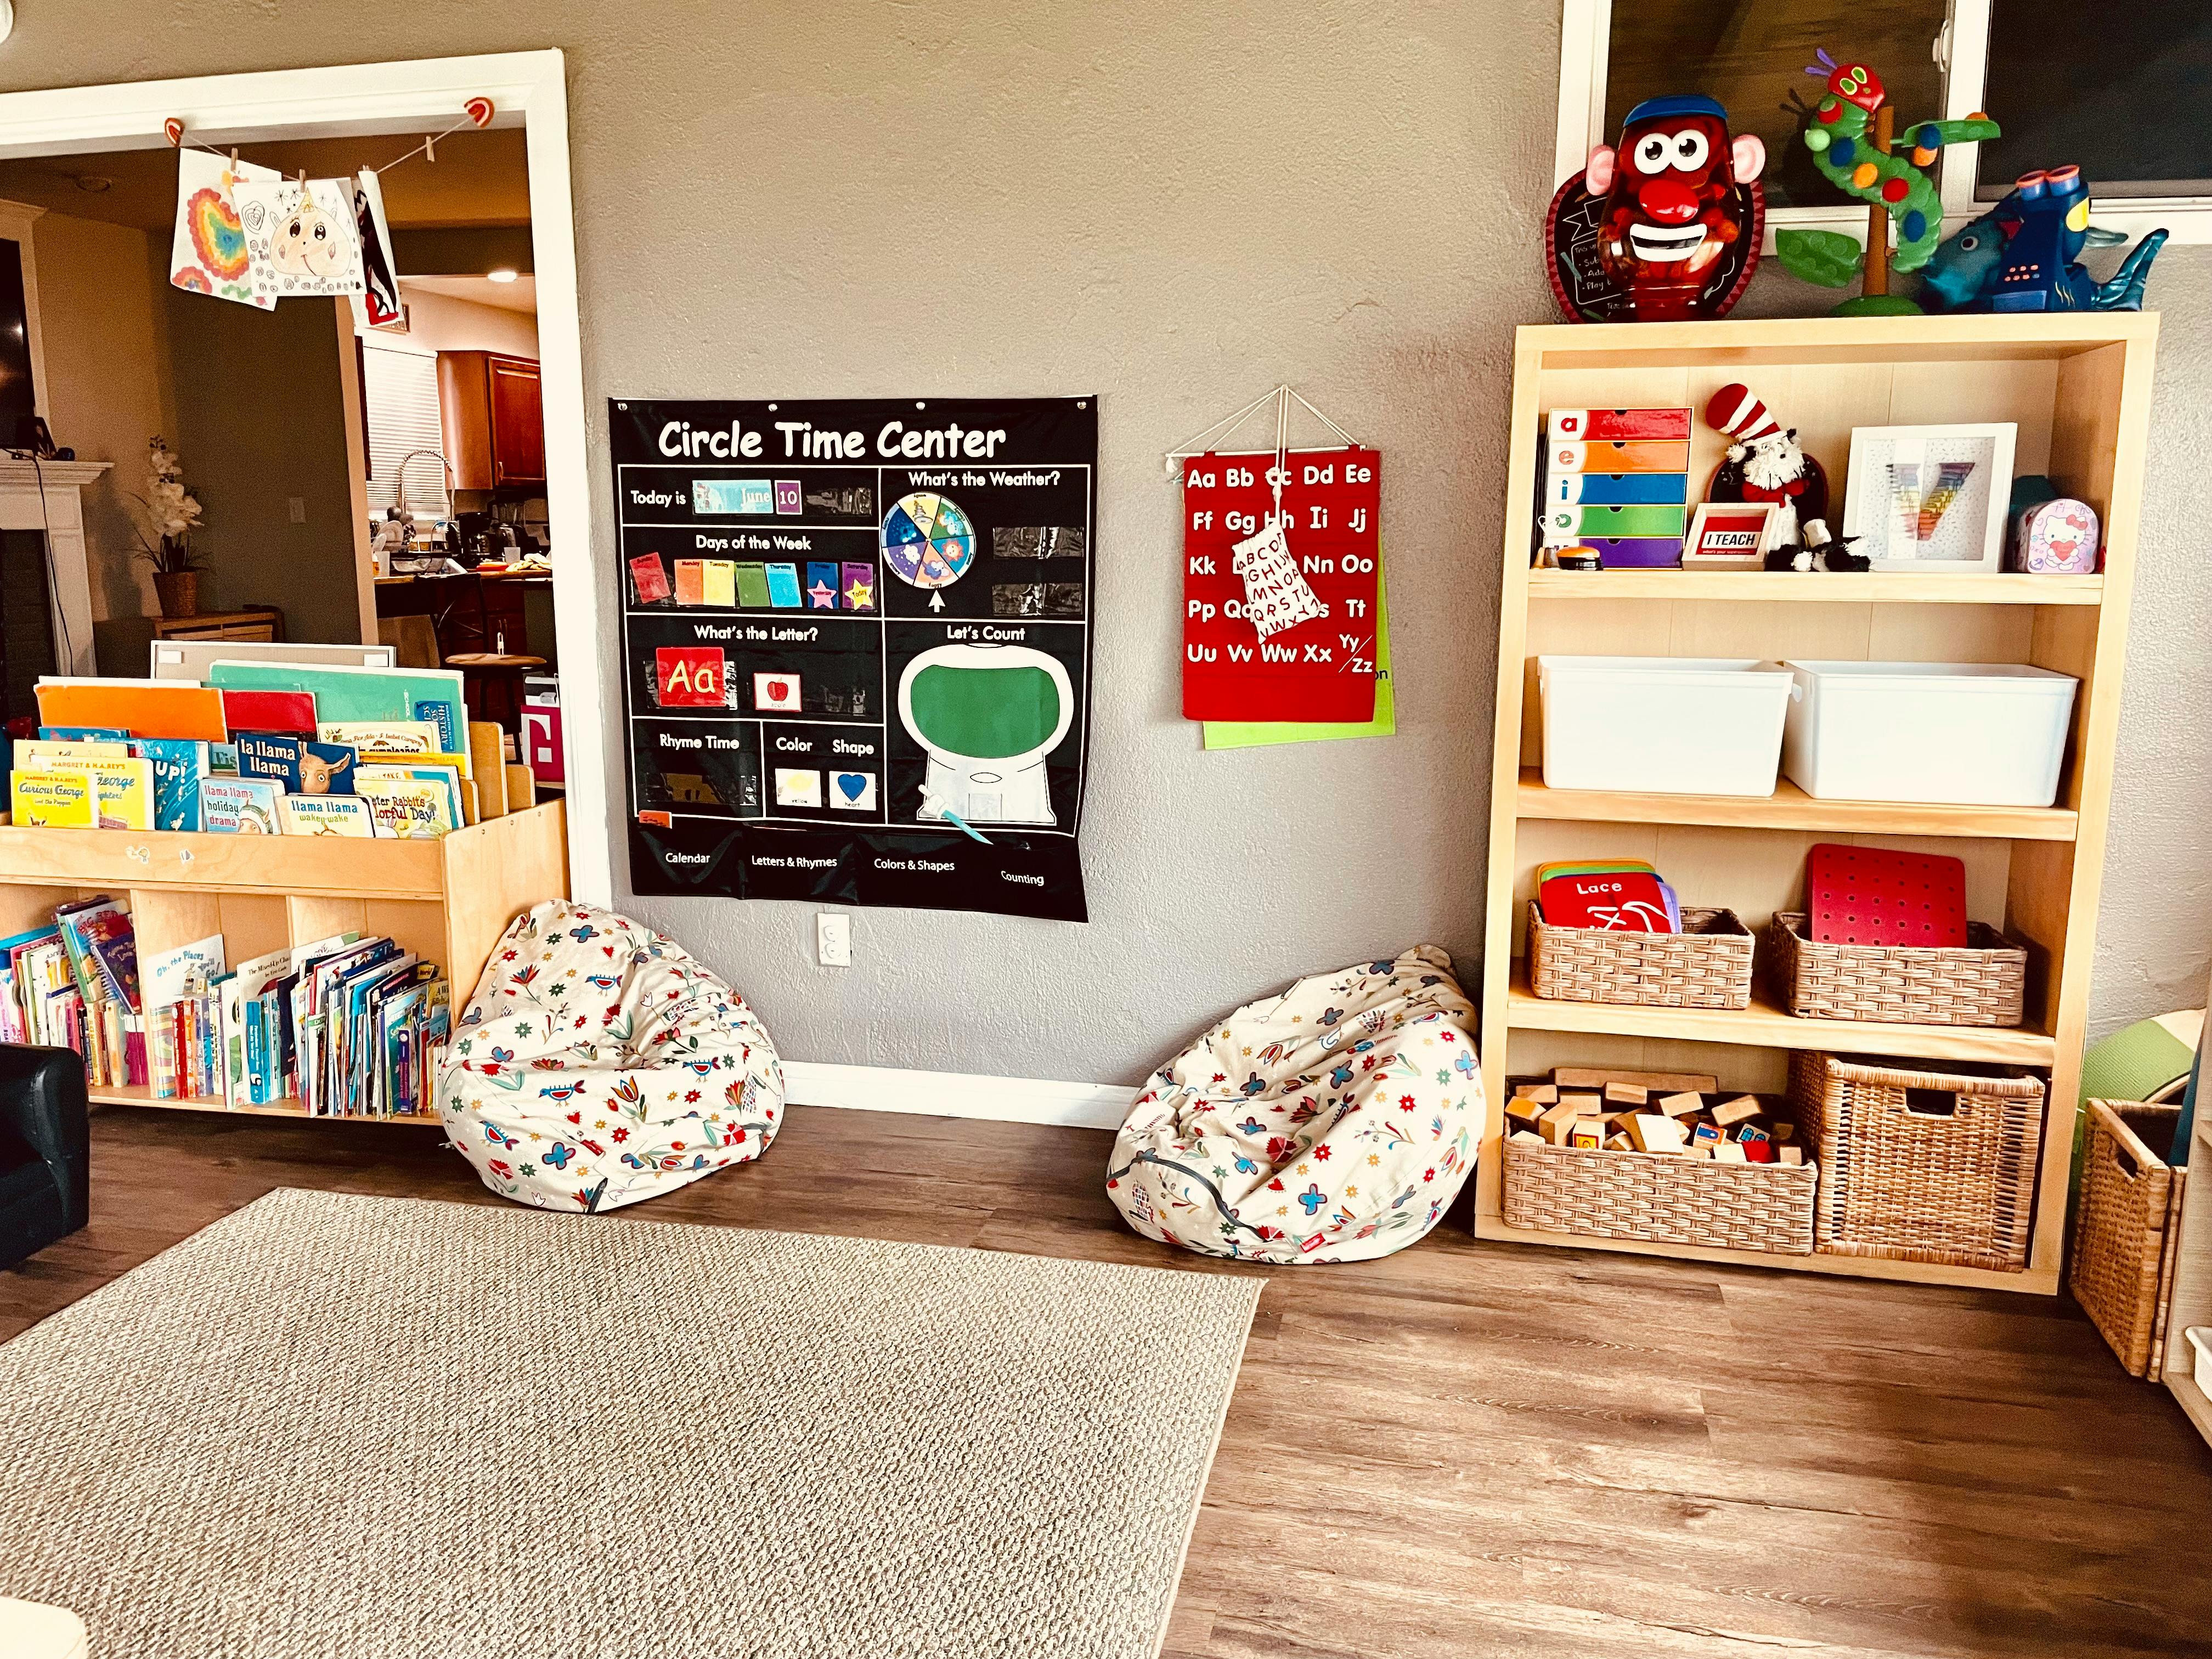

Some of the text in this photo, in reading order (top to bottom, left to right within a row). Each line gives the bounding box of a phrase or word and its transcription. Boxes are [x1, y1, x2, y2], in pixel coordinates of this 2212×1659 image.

[1586, 281, 1604, 291] Play
[1561, 416, 1578, 432] a
[658, 420, 1006, 459] Circle Time Center
[1558, 449, 1575, 465] e
[908, 470, 1060, 487] What's the Weather?
[1187, 469, 1216, 488] Aa
[1226, 467, 1254, 487] Bb
[1304, 464, 1334, 485] Dd
[1345, 464, 1371, 484] Ee
[630, 487, 798, 507] Today is June 10
[1561, 479, 1568, 500] i
[1193, 506, 1366, 535] Ff Gg Hh Ii Jj
[695, 534, 812, 552] Days of the Week
[1707, 534, 1756, 545] I TEACH
[1189, 556, 1216, 575] Kk
[1304, 555, 1334, 574] Nn
[1341, 554, 1373, 574] Oo
[852, 589, 867, 597] Today
[1188, 599, 1216, 623] Pp
[1345, 599, 1366, 618] Tt
[694, 625, 819, 641] What's the Letter?
[946, 625, 1025, 640] Let's Count
[1187, 634, 1359, 662] Uu Vv Ww Xx Yy
[1352, 658, 1373, 673] Zz
[666, 660, 715, 694] Aa
[437, 705, 448, 745] HISTORY
[659, 733, 740, 751] Rhyme Time
[776, 737, 813, 752] Color
[832, 738, 874, 757] Shape
[256, 741, 296, 760] llama
[155, 760, 187, 784] UP!
[250, 757, 290, 776] llama
[19, 782, 84, 799] Curious George
[204, 785, 253, 799] llama llama
[207, 800, 239, 816] holiday
[291, 800, 358, 813] llama llama
[392, 796, 425, 807] Rabbit's
[209, 814, 236, 826] drama
[300, 814, 348, 823] wakey-wake
[410, 807, 436, 823] Day!
[665, 852, 710, 864] Calendar
[752, 855, 838, 870] Letters & Rhymes
[874, 858, 955, 873] Colors & Shapes
[1000, 870, 1045, 887] Counting
[1576, 883, 1623, 895] Lace
[183, 950, 204, 960] Places
